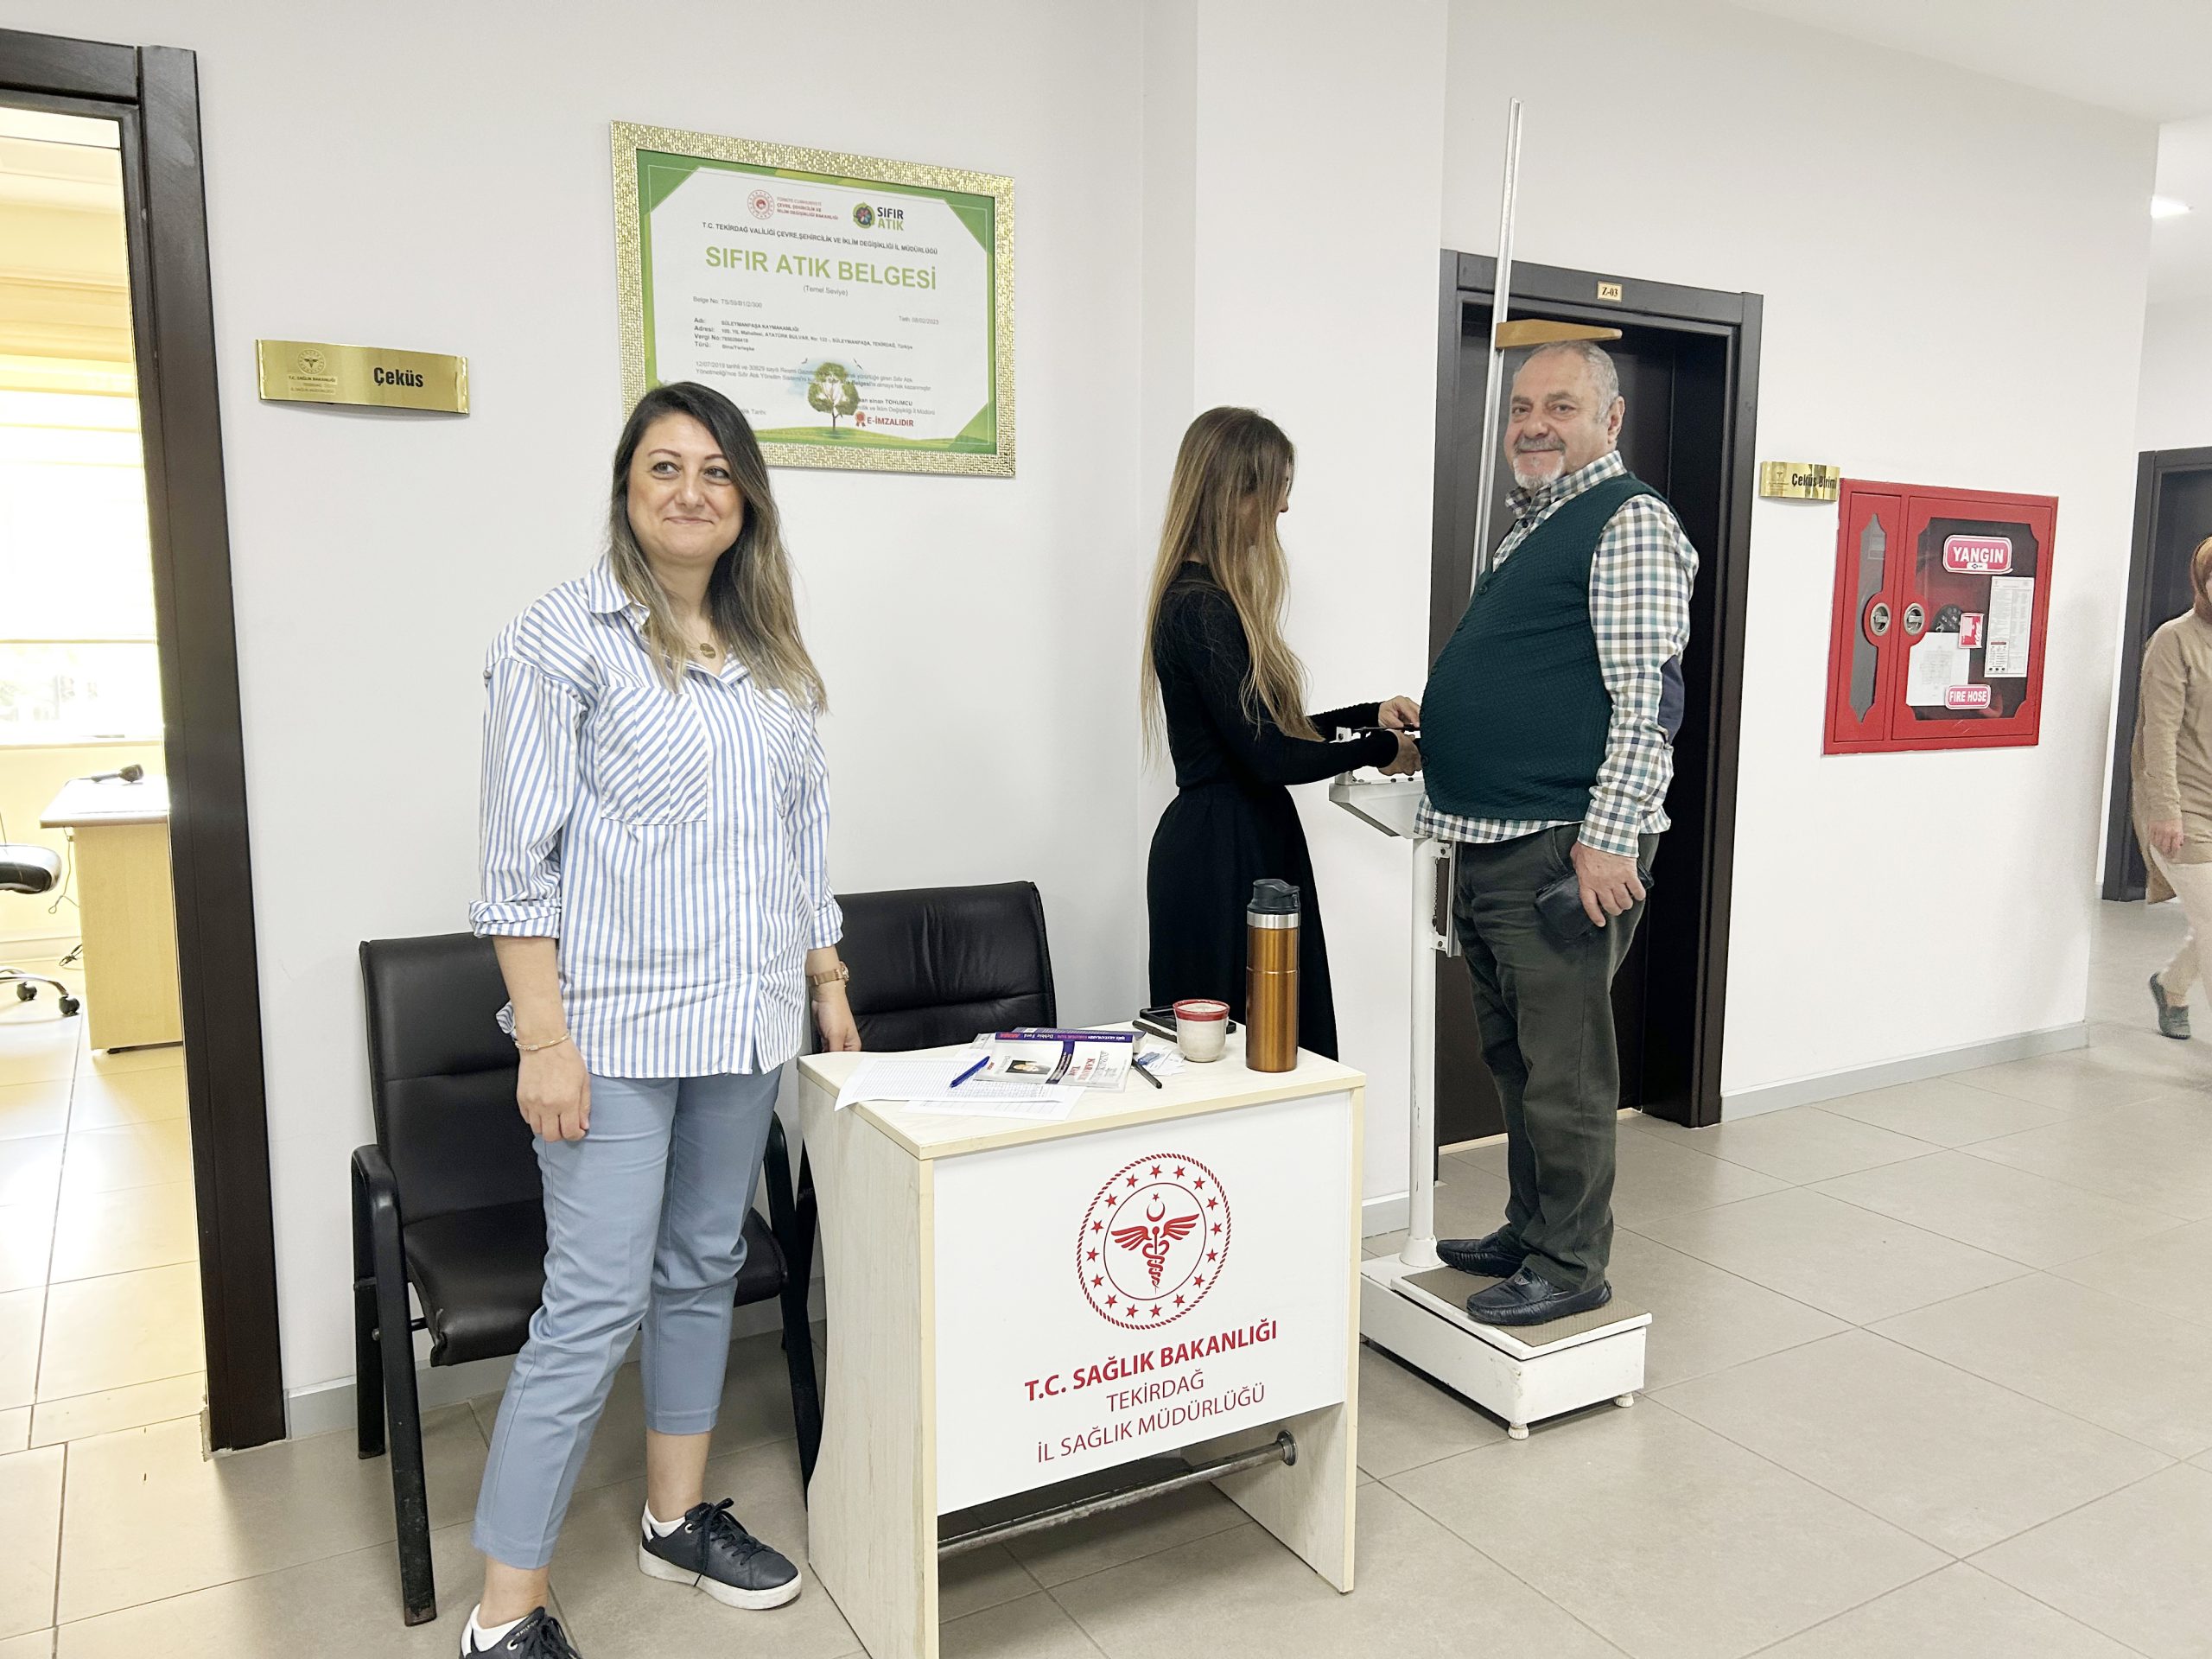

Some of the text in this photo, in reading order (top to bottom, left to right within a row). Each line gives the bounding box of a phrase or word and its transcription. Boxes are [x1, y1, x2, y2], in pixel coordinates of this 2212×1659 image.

[877, 207, 904, 219] SIFIR
[877, 218, 904, 231] ATIK
[715, 223, 748, 232] TEKİRDAĞ
[749, 227, 776, 236] VALİLİĞİ
[842, 237, 859, 245] İKLİM
[859, 239, 894, 250] DEĞİŞİKLİĞİ
[705, 246, 937, 290] SIFIR ATIK BELGESİ
[803, 284, 849, 296] (Temel Seviye)
[1602, 287, 1618, 297] Z-03
[693, 296, 709, 304] Belge
[373, 366, 424, 388] Çeküs
[867, 415, 914, 427] E-İMZALIDIR
[1791, 473, 1817, 487] Çeküs
[1953, 546, 2005, 563] YANGIN
[1948, 690, 1987, 702] FIRE HOSE
[1025, 1318, 1278, 1402] T.C. SAĞLIK BAKANLIĞI
[1106, 1368, 1205, 1413] TEKİRDAĞ
[1037, 1382, 1267, 1464] İL SAĞLIK MÜDÜRLÜĞÜ
